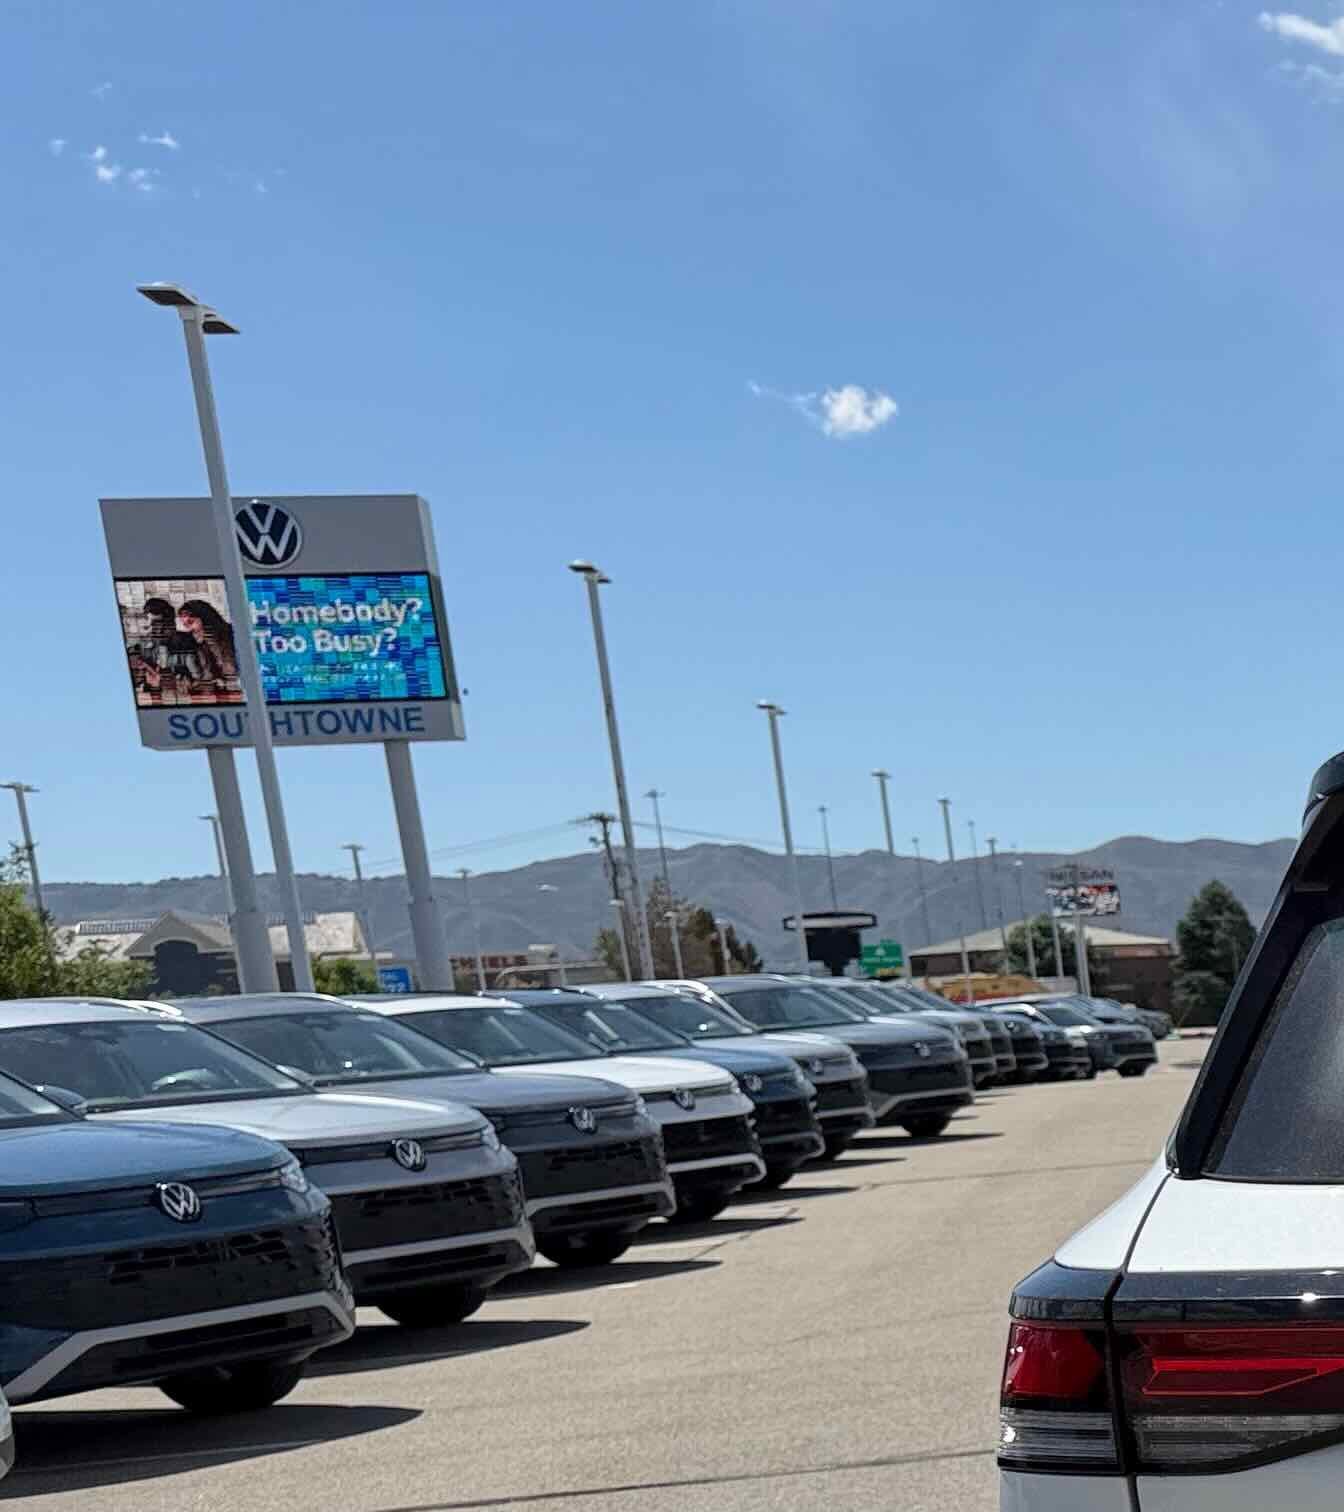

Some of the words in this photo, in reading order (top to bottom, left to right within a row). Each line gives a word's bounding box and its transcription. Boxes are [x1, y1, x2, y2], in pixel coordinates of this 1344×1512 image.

[234, 500, 301, 568] VW
[250, 598, 423, 627] Homebody?
[252, 629, 307, 654] Too
[312, 627, 397, 657] Busy?
[168, 706, 425, 740] SOUHTOWNE
